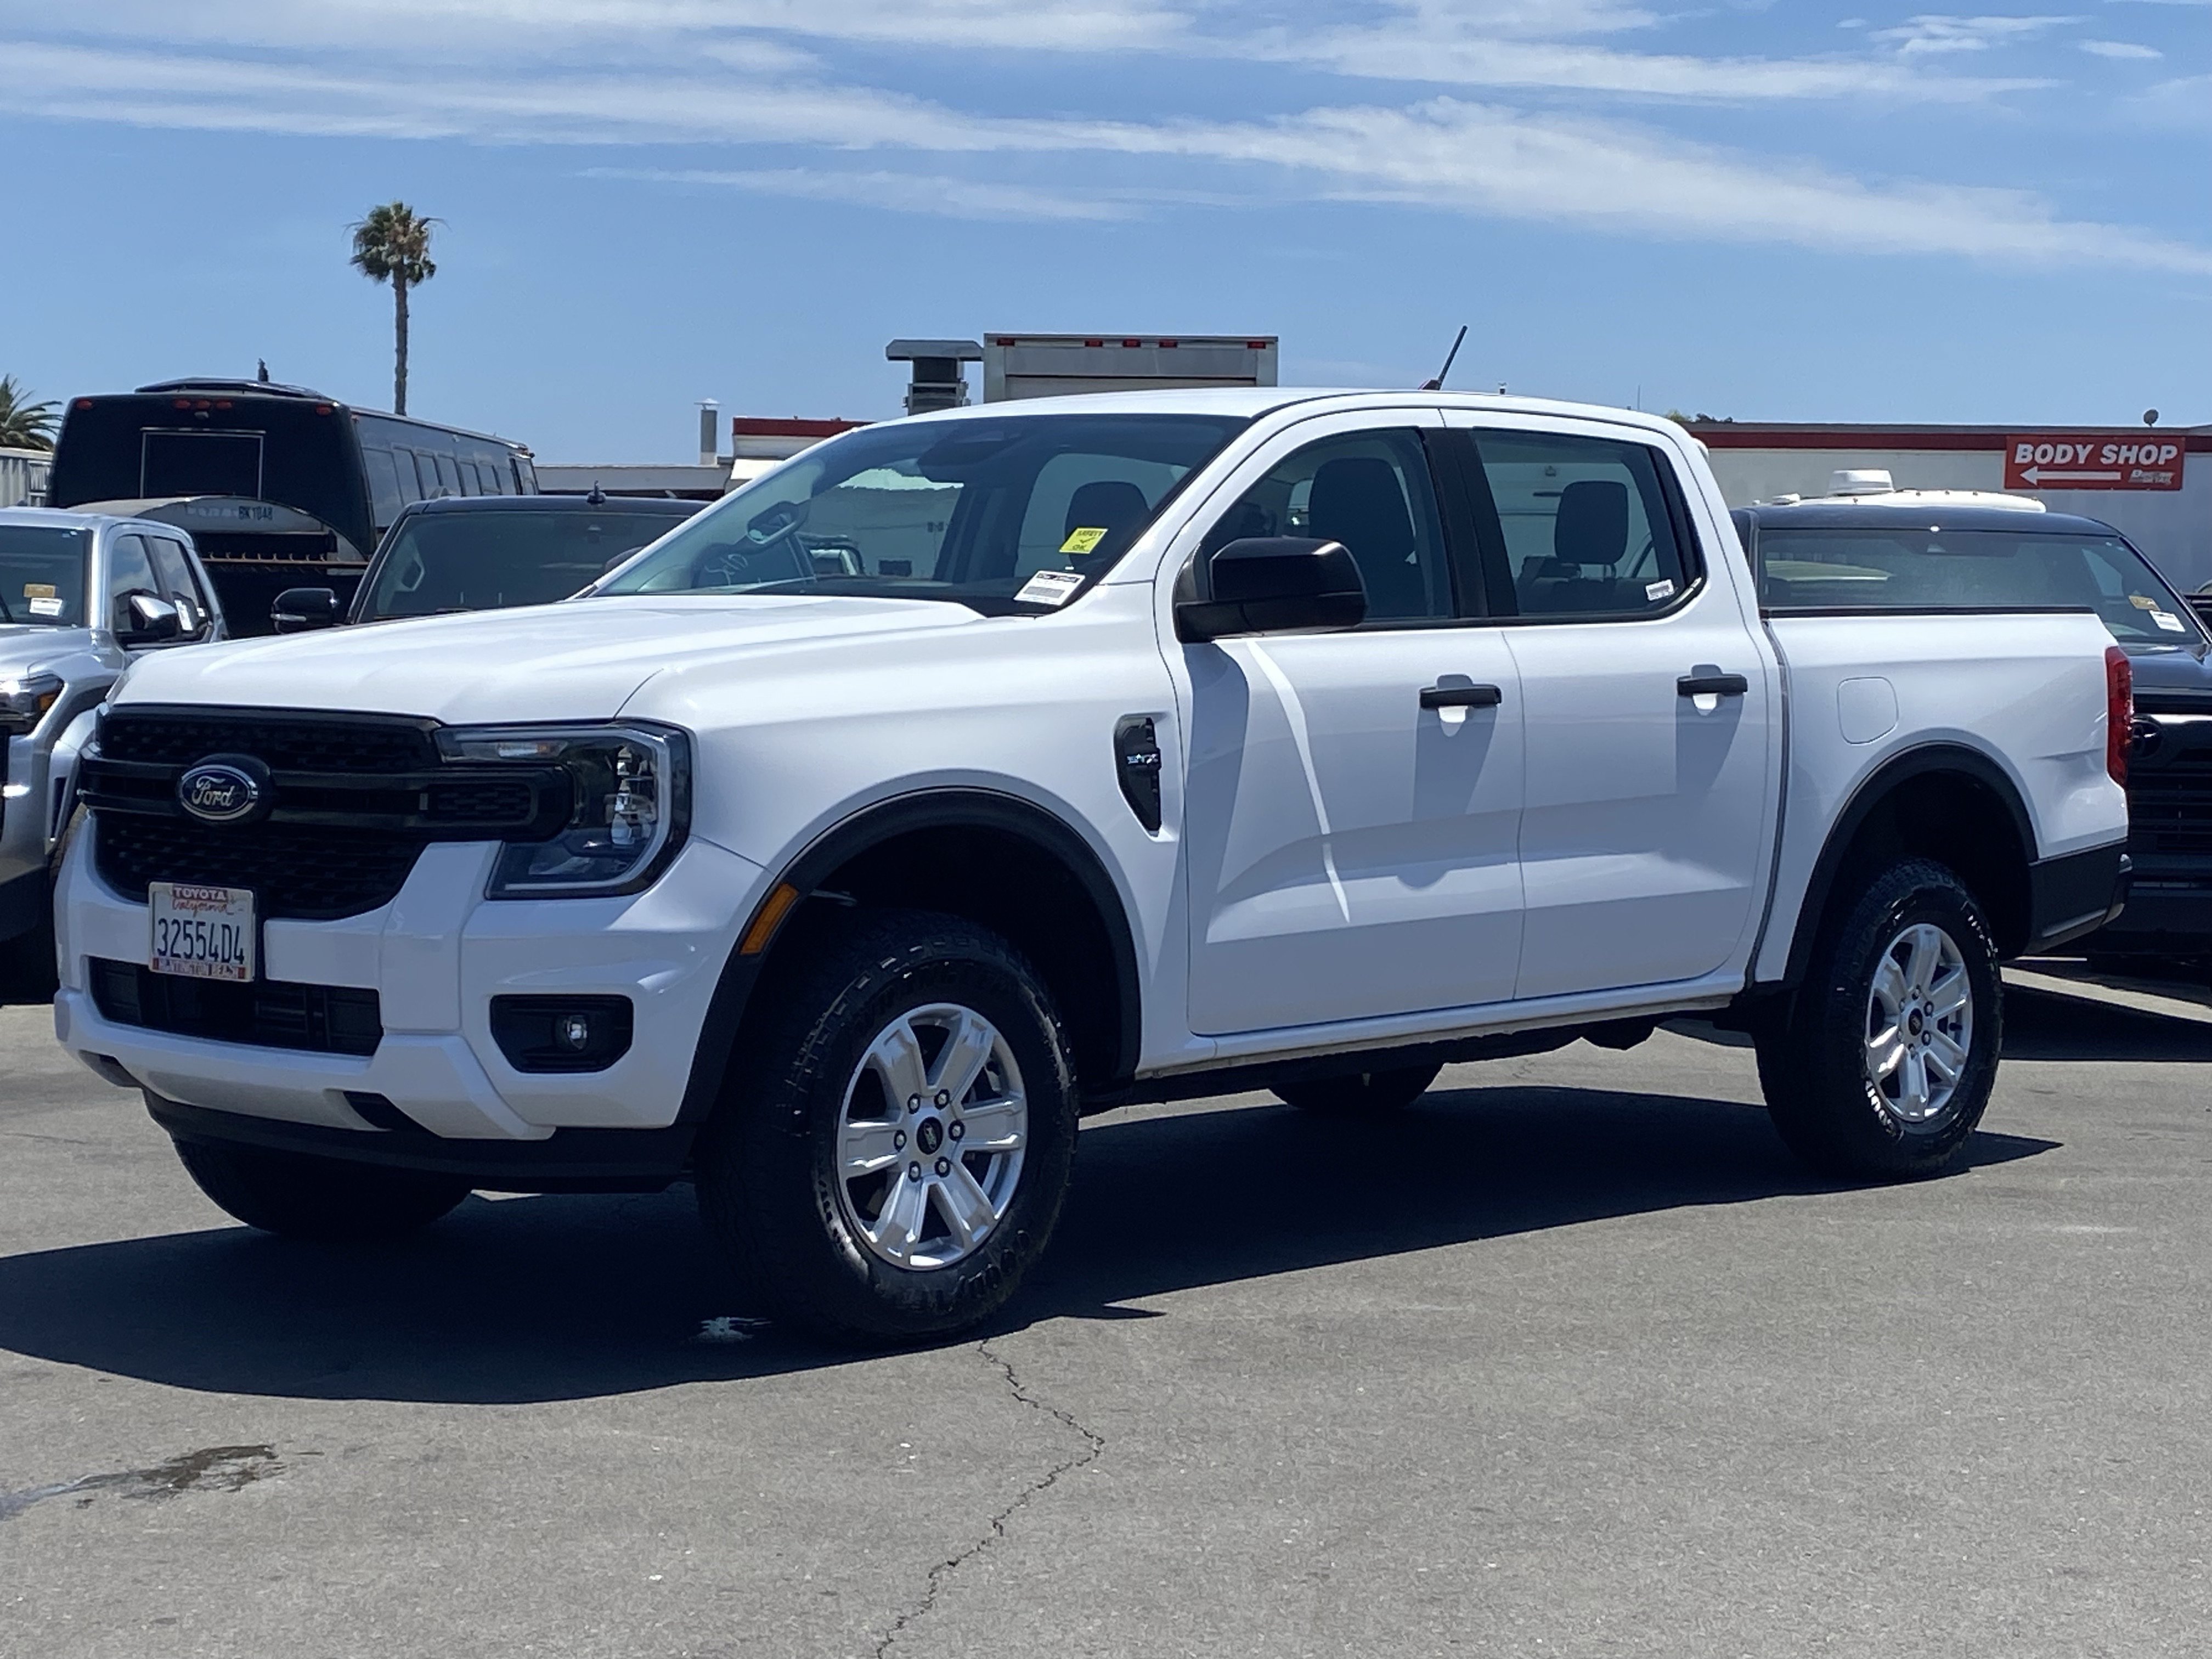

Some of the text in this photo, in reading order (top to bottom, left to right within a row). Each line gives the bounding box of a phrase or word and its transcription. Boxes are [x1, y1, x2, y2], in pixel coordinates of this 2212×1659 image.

[2014, 443, 2178, 465] BODY SHOP
[192, 775, 235, 806] Ford
[174, 887, 227, 901] TOYOTA
[157, 918, 245, 964] 32554D4
